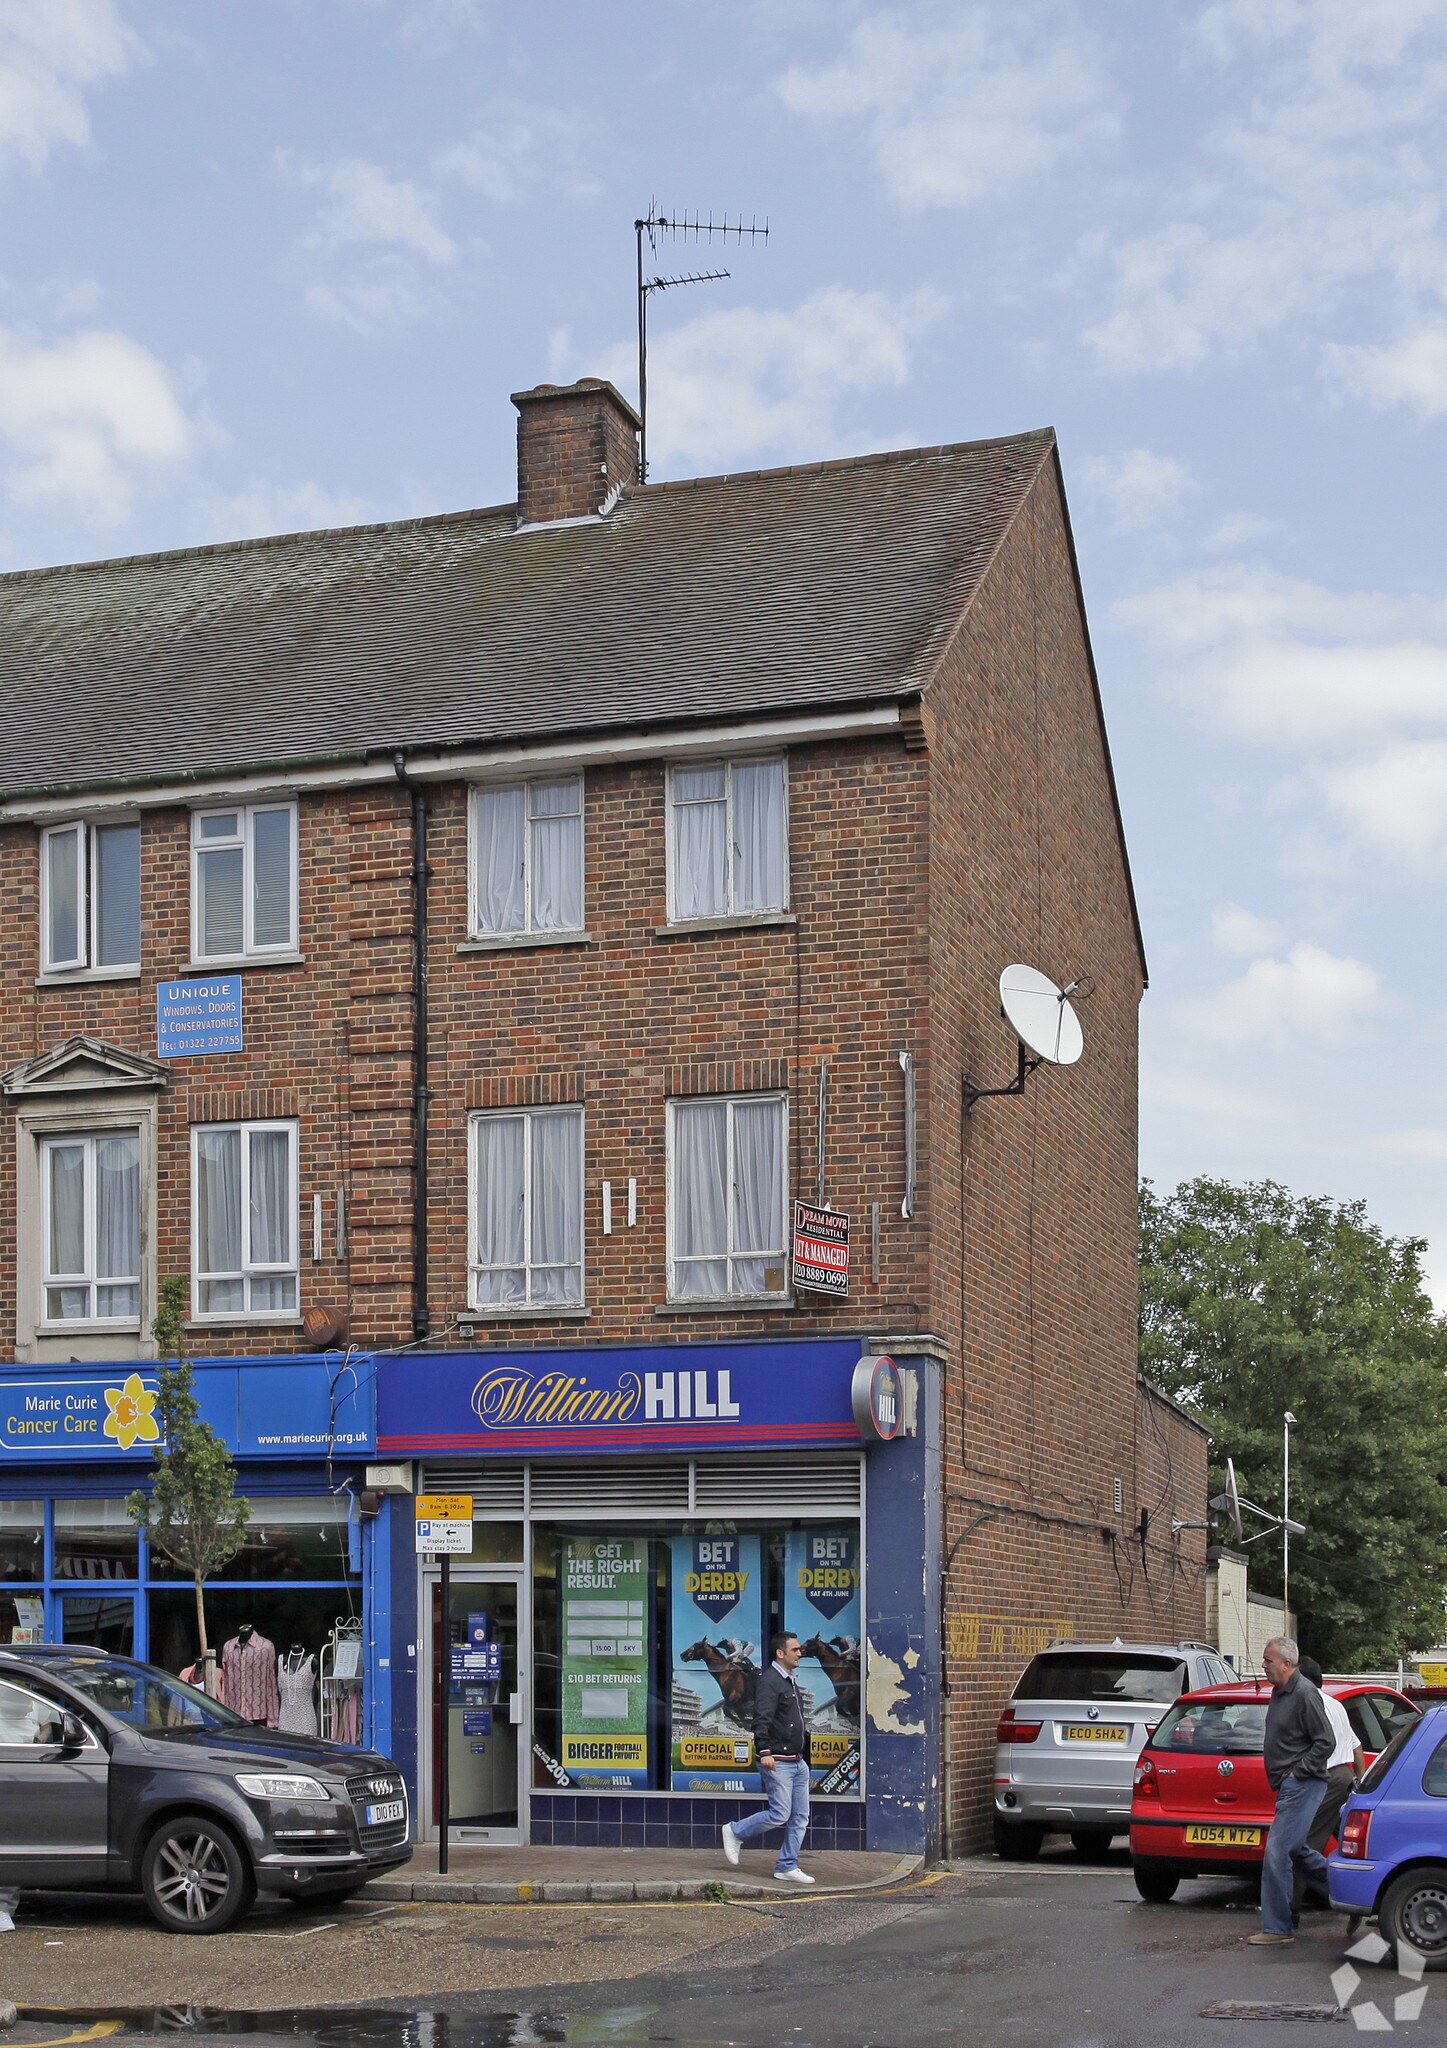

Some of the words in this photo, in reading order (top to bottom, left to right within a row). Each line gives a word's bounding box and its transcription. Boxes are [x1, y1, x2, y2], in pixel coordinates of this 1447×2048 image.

[169, 984, 231, 1001] UNIQUE
[208, 1001, 236, 1015] DOORS
[161, 1022, 167, 1034] &
[170, 1017, 239, 1033] CONSERVATORIES
[179, 1038, 205, 1050] 01322
[208, 1035, 240, 1047] 227755
[806, 1223, 845, 1239] RESIDENTIAL
[804, 1241, 810, 1261] &
[810, 1243, 847, 1267] MANAGED
[806, 1266, 825, 1283] 8889
[826, 1271, 847, 1286] 0699
[25, 1395, 62, 1411] Marie
[65, 1394, 98, 1410] Curie
[471, 1366, 642, 1430] William
[644, 1370, 740, 1419] HILL
[878, 1394, 896, 1424] HILL
[6, 1416, 59, 1434] Cancer
[63, 1414, 98, 1433] Care
[420, 1522, 429, 1536] P
[595, 1543, 622, 1558] GET
[699, 1542, 734, 1563] BET
[812, 1538, 849, 1559] BET
[567, 1559, 594, 1573] THE
[597, 1559, 641, 1573] RIGHT
[567, 1574, 617, 1589] RESULT.
[685, 1571, 750, 1593] DERBY
[798, 1568, 860, 1589] DERBY
[568, 1674, 584, 1683] £10
[585, 1674, 601, 1683] BET
[602, 1674, 642, 1683] RETURNS
[568, 1742, 613, 1760] BIGGER
[613, 1743, 642, 1752] FOOTBALL
[685, 1743, 732, 1754] OFFICIAL
[811, 1741, 846, 1752] FICIAL
[613, 1751, 640, 1760] PAYOUTS
[546, 1759, 570, 1787] 20p
[822, 1770, 842, 1793] DEBIT
[840, 1751, 860, 1774] CARD
[611, 1775, 633, 1786] HILL
[724, 1780, 745, 1791] HILL
[836, 1779, 849, 1793] VISA
[389, 1803, 400, 1818] FEX
[1229, 1829, 1255, 1843] WTZ
